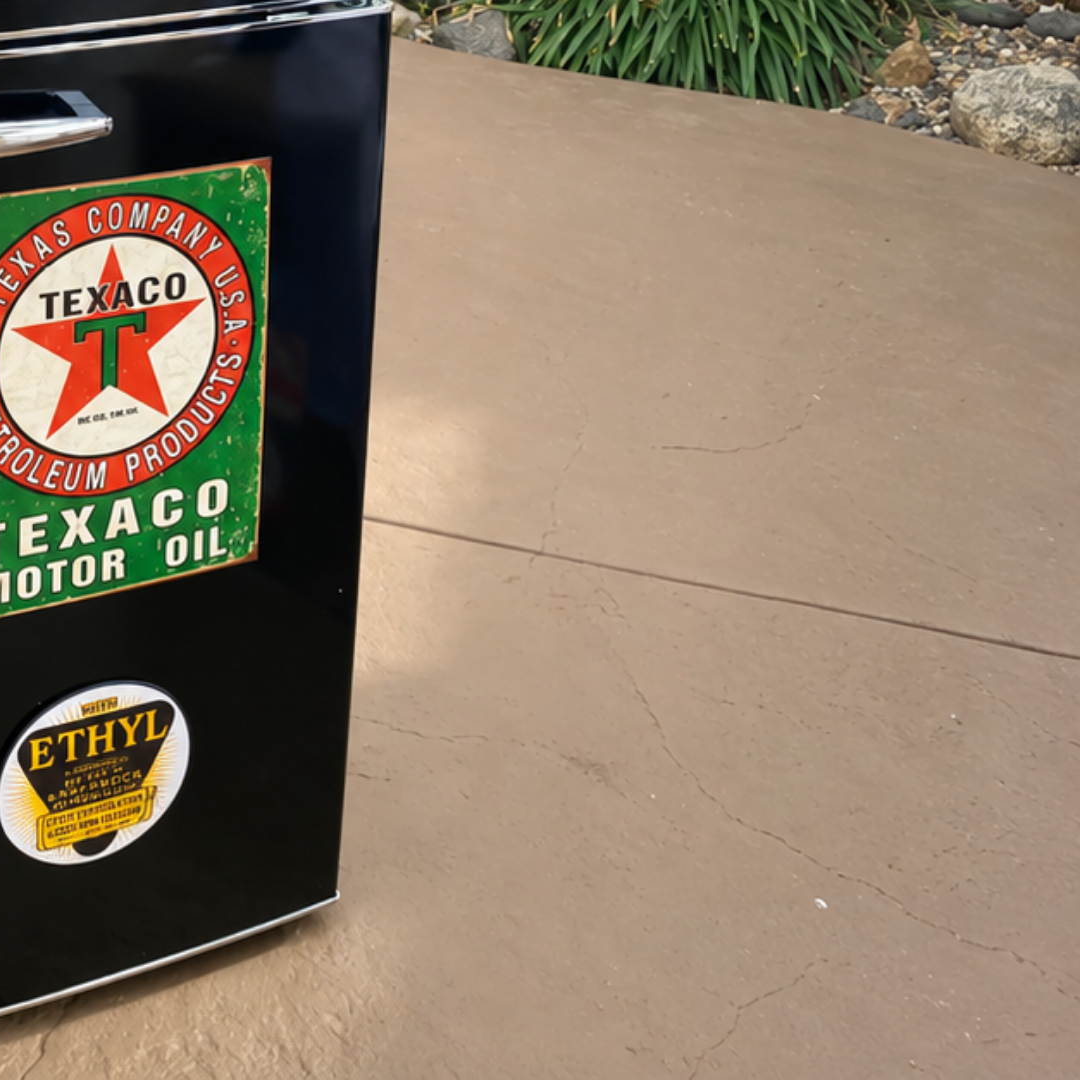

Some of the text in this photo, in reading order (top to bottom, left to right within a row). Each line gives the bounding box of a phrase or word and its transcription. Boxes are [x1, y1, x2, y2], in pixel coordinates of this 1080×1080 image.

[87, 201, 223, 260] COMPANY
[39, 272, 187, 319] TEXACO
[74, 311, 147, 391] T
[125, 353, 242, 482] PRODUCTS
[163, 526, 229, 568] OIL
[29, 709, 169, 771] ETHYL
